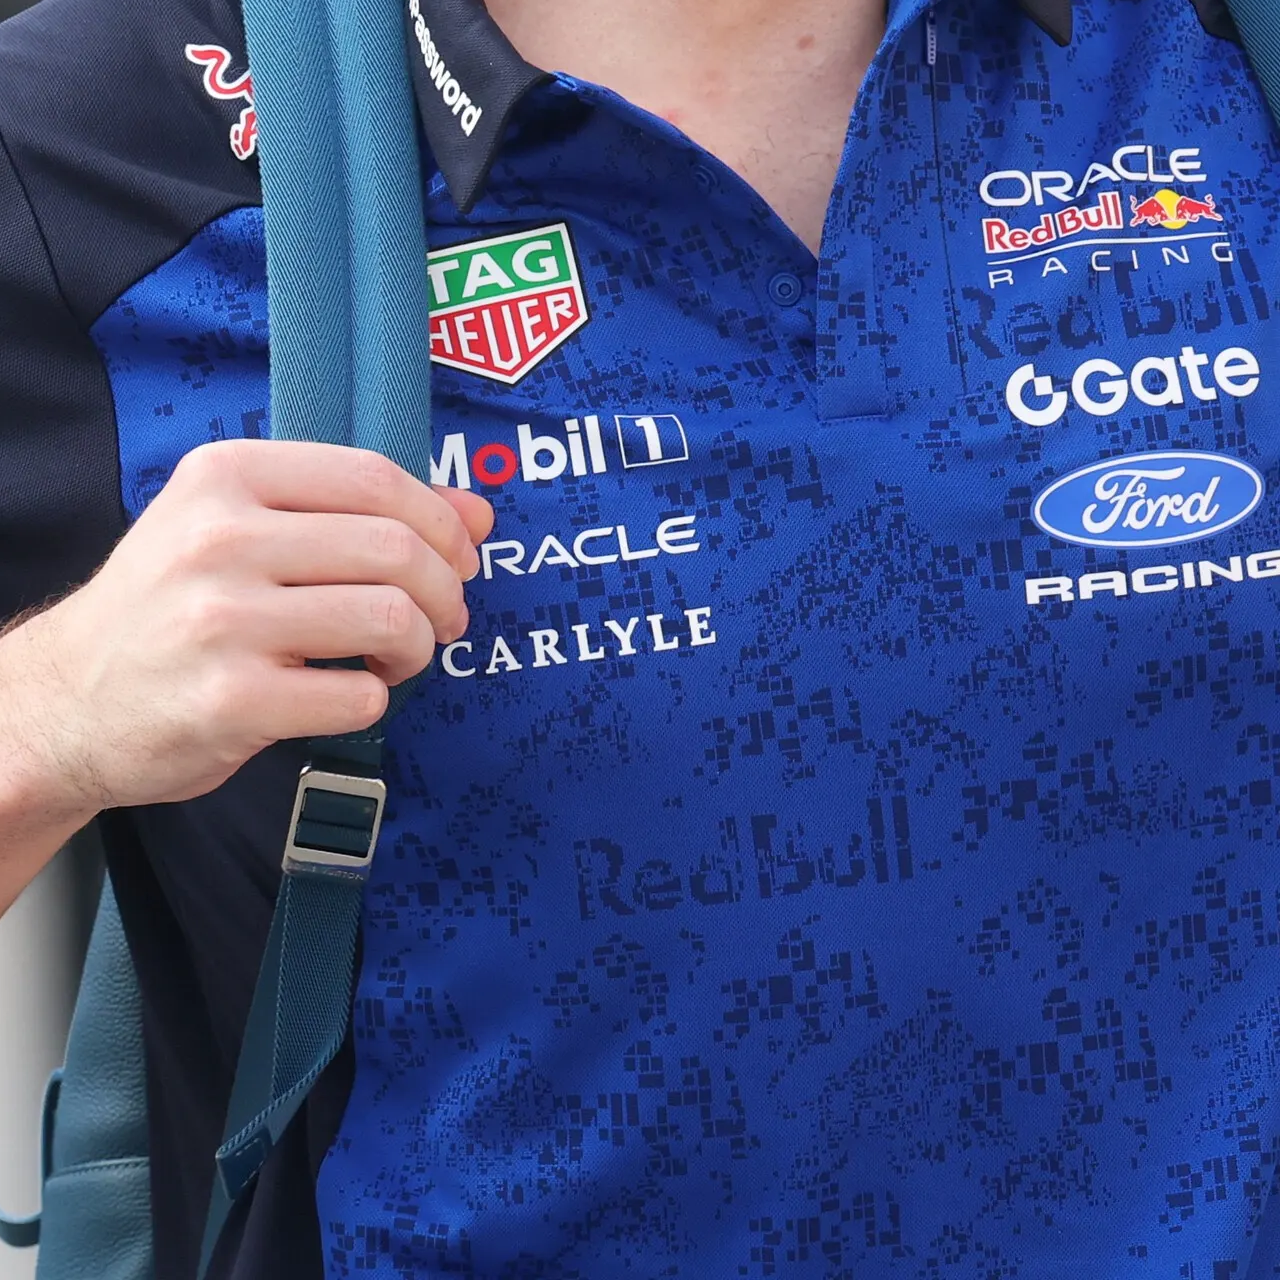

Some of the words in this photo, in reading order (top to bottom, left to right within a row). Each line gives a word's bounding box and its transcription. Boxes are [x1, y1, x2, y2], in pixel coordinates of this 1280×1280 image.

[978, 145, 1208, 207] ORACLE
[427, 239, 561, 305] TAG
[987, 242, 1235, 290] RACING
[429, 291, 574, 371] HEUER
[429, 415, 608, 491] Mobil
[1082, 465, 1221, 534] Ford
[468, 515, 702, 582] RACLE
[441, 606, 718, 678] CARLYLE
